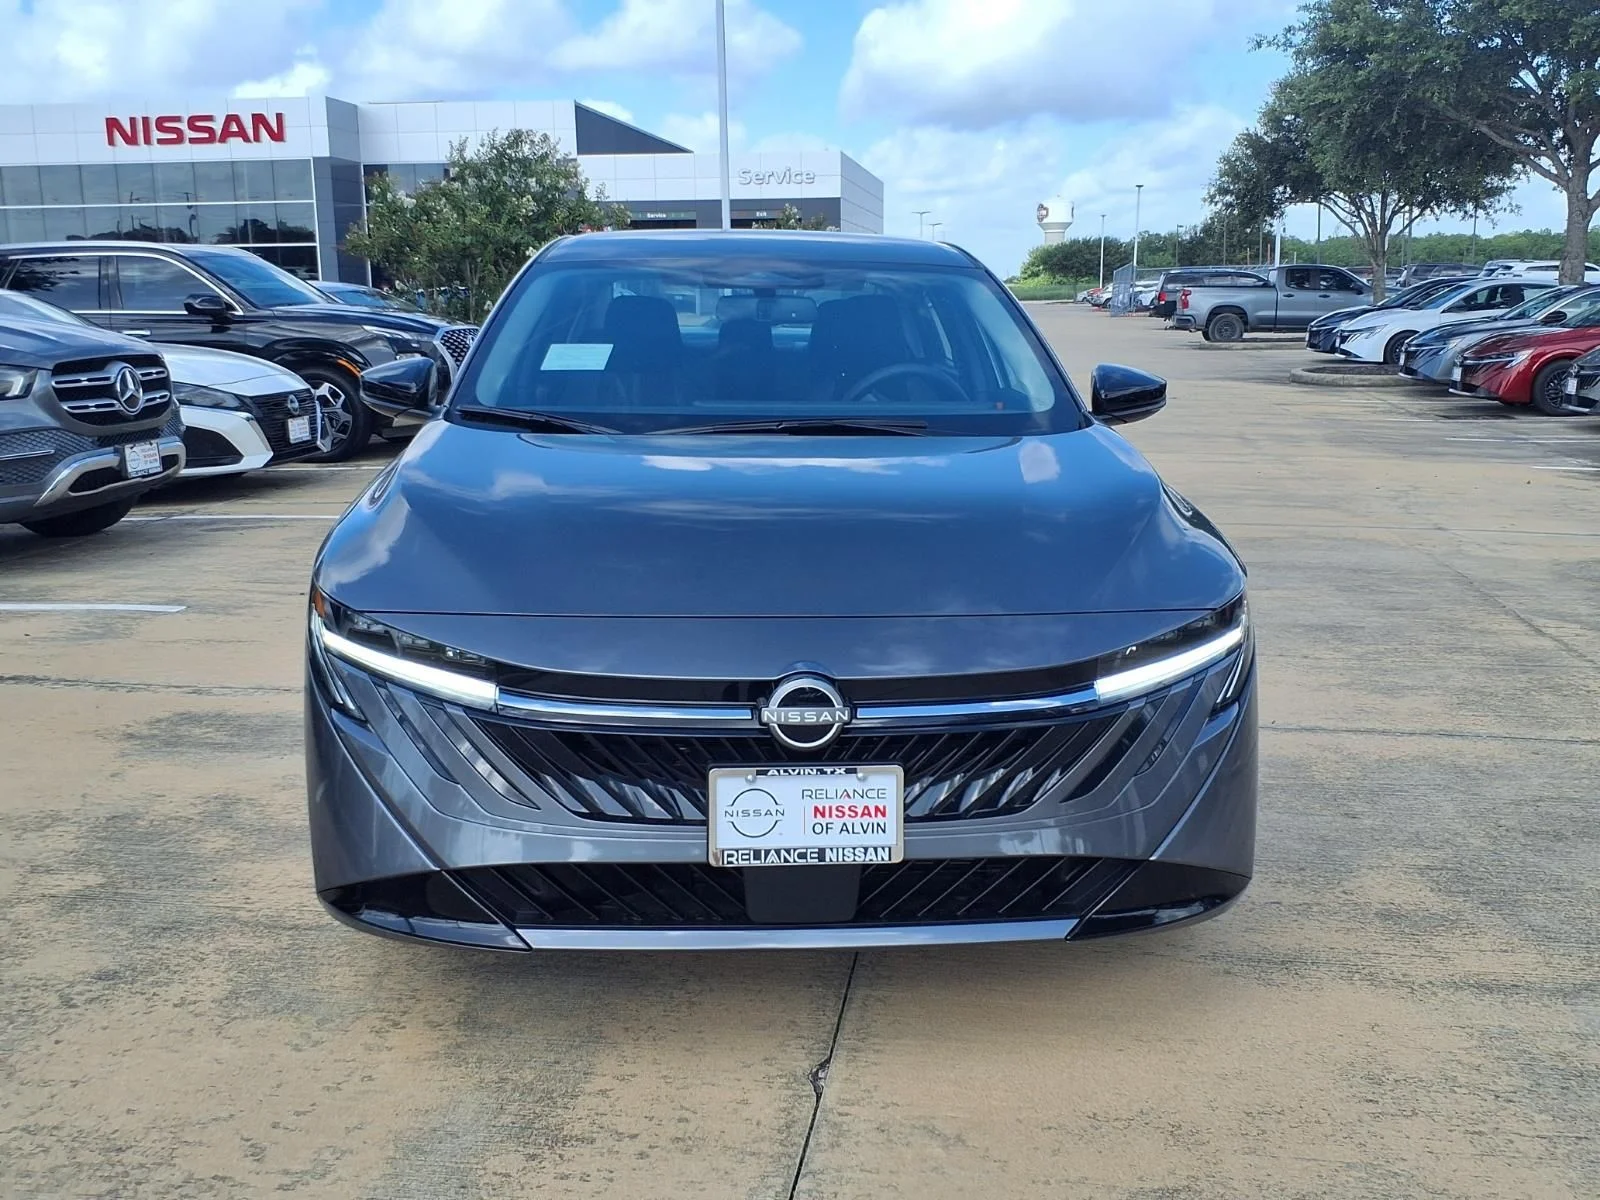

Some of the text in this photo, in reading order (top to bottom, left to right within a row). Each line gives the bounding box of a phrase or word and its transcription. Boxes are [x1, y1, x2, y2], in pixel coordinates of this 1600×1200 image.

[105, 112, 286, 146] NISSAN
[739, 167, 815, 185] Service
[764, 710, 849, 723] NISSAN
[823, 767, 847, 775] TX
[801, 788, 887, 800] RELIANCE
[724, 808, 785, 818] NISSAN
[813, 804, 887, 819] NISSAN
[812, 822, 887, 835] OF ALVIN
[723, 847, 889, 865] RELIANCE NISSAN
